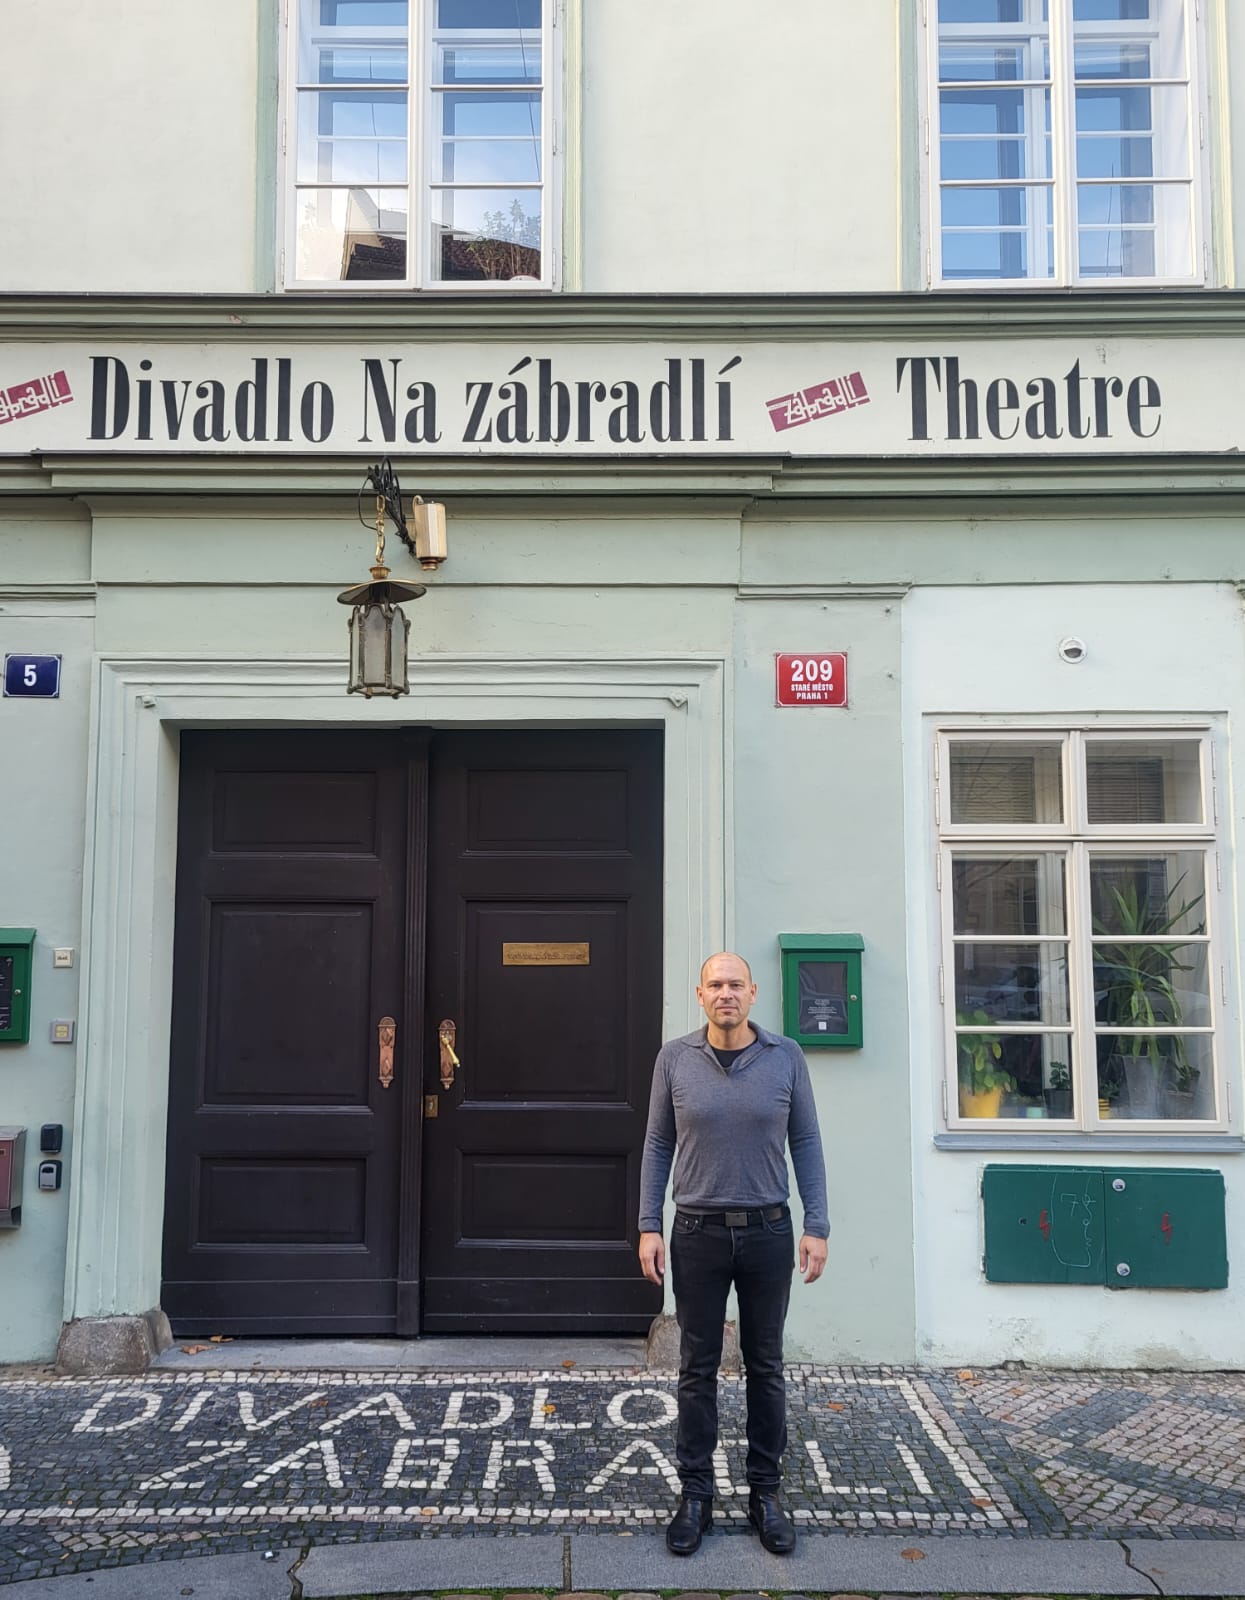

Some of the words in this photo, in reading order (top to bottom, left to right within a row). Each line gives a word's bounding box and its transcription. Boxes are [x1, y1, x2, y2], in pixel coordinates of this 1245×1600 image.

[87, 355, 335, 443] Divadlo
[357, 358, 442, 443] Na
[462, 355, 742, 443] zábradlí
[896, 356, 1162, 441] Theatre
[23, 664, 38, 687] 5
[790, 659, 833, 682] 209
[790, 682, 811, 692] STARÉ
[796, 692, 822, 700] PRAHA
[824, 692, 828, 700] 1
[71, 1387, 681, 1433] DIVADLO
